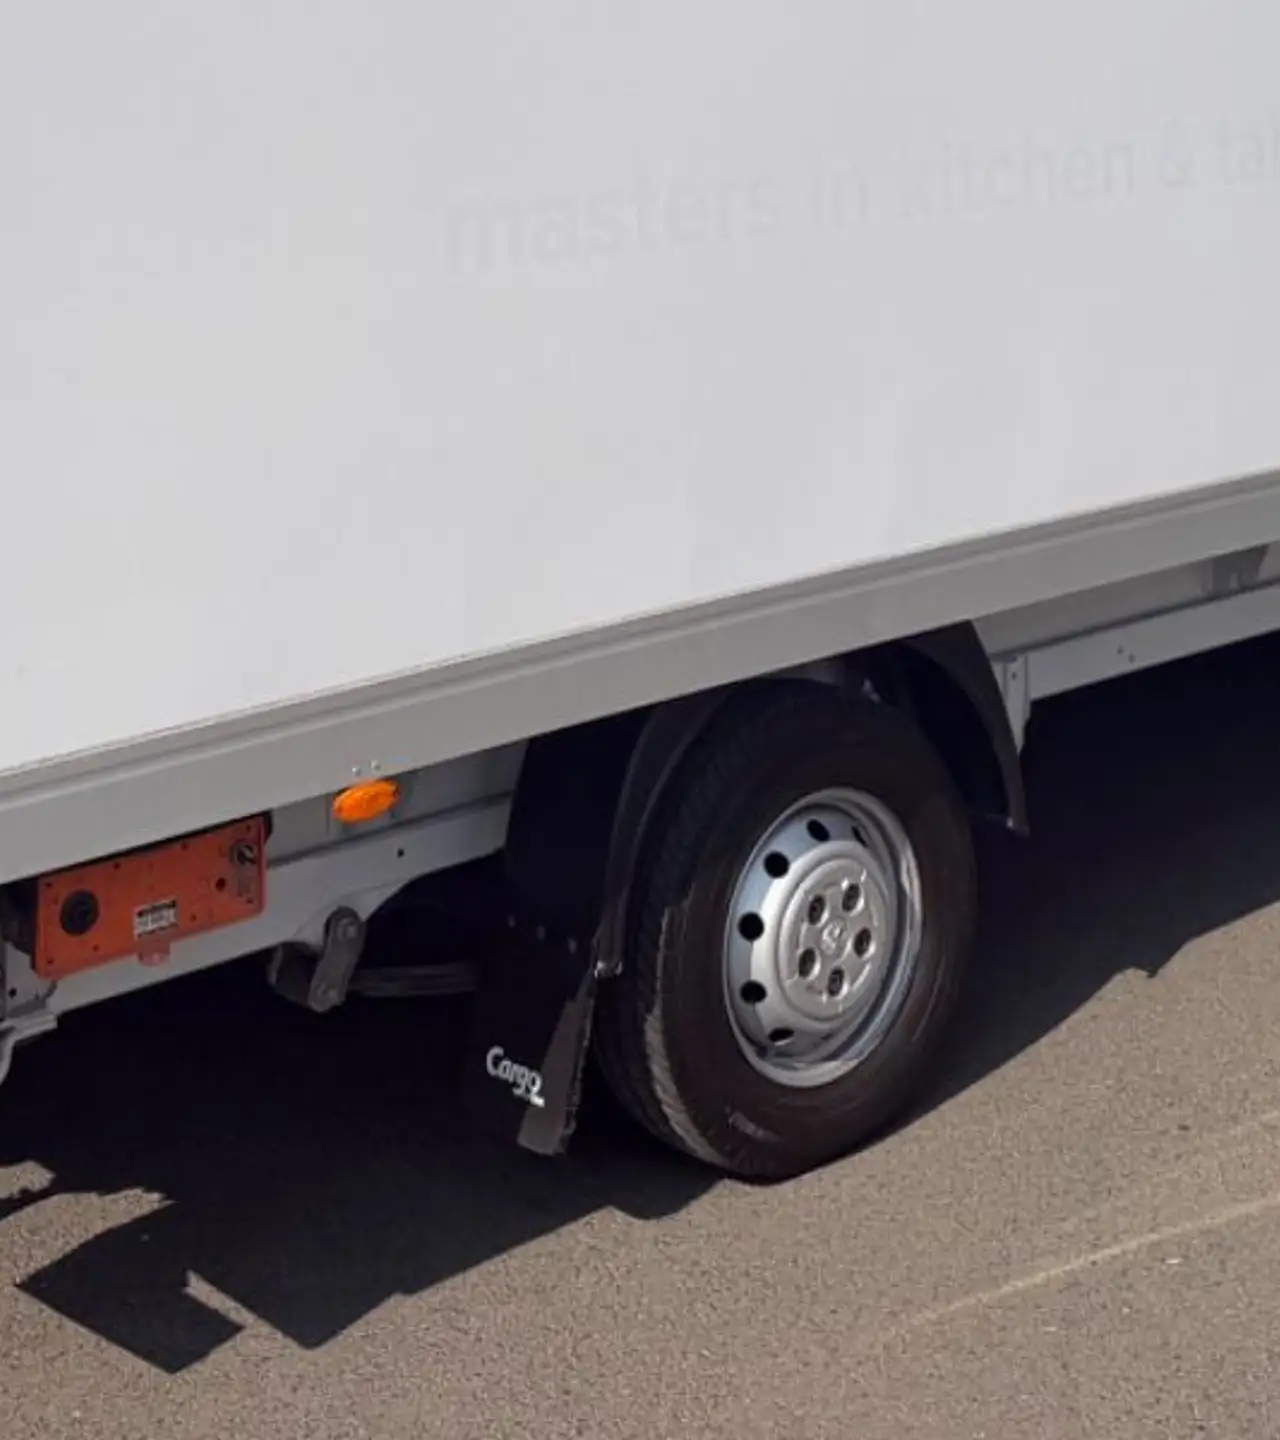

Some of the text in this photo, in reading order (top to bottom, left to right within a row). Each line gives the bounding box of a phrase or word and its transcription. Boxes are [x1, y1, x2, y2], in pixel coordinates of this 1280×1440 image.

[444, 172, 779, 273] masters
[810, 150, 868, 228] in
[899, 128, 1136, 220] kitchen
[1156, 114, 1196, 190] &
[486, 1045, 543, 1097] Cargo
